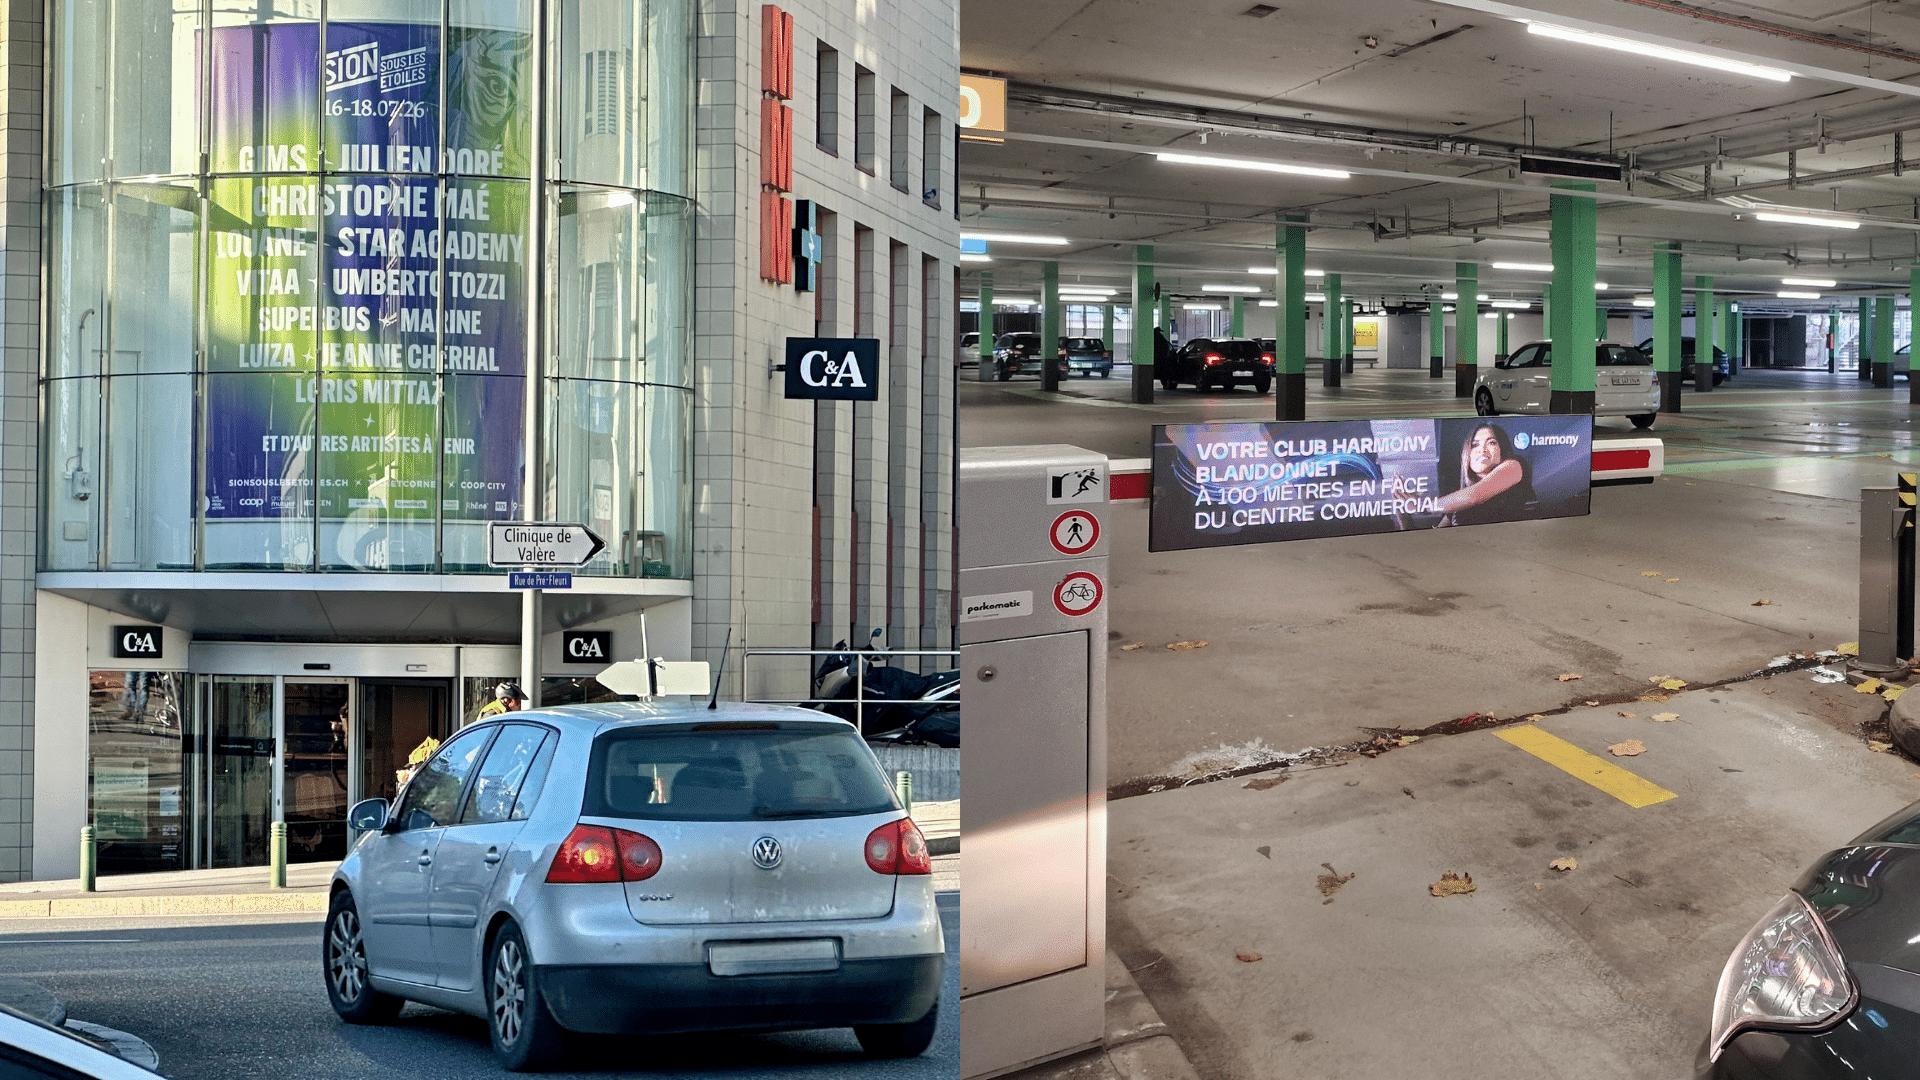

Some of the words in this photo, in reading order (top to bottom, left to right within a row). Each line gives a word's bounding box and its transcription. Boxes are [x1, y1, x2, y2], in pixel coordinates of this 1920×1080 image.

[326, 49, 378, 86] SION
[380, 57, 407, 72] SOUS
[408, 52, 426, 66] LES
[380, 67, 426, 89] ETOILES
[325, 99, 425, 118] 16-18.07.26
[239, 144, 307, 172] GIMS
[338, 144, 431, 172] JULIEN
[253, 184, 427, 217] CHRISTOPHE
[434, 183, 490, 221] MAÉ
[216, 228, 307, 258] LOUANE
[338, 227, 405, 257] STAR
[410, 229, 524, 263] ACADEMY
[236, 268, 300, 296] VITAA
[332, 268, 438, 297] UMBERTO
[449, 272, 506, 300] TOZZI
[239, 343, 296, 368] LUIZA
[321, 343, 402, 369] JEANNE
[800, 350, 867, 388] C&A
[295, 378, 358, 403] LORIS
[262, 435, 278, 452] ET
[280, 435, 348, 452] D'AURES
[351, 435, 420, 453] ARTISTES
[422, 432, 433, 454] À
[442, 437, 476, 455] ENIR
[1196, 441, 1268, 460] VOTRE
[1274, 439, 1327, 457] CLUB
[1332, 435, 1430, 455] HARMONY
[1531, 433, 1579, 448] harmony
[1196, 460, 1339, 484] BLANDONNET
[228, 478, 349, 487] SIONSOUSLESETOIES.CH
[460, 481, 485, 490] COOP
[487, 482, 506, 491] CITY
[1195, 485, 1212, 506] À
[1218, 486, 1257, 505] 100
[1263, 480, 1344, 502] MÈTRES
[1349, 480, 1376, 497] EN
[1381, 476, 1429, 495] FACE
[239, 498, 264, 508] coop
[1194, 511, 1226, 530] DU
[1232, 505, 1315, 527] CENTRE
[1320, 496, 1444, 521] COMMERCIAL
[504, 528, 554, 546] Clinique
[556, 528, 572, 543] de
[517, 546, 556, 561] Valère
[514, 574, 526, 583] Rue
[526, 574, 534, 583] de
[967, 600, 1021, 614] parkomatic
[123, 632, 157, 652] C&A
[569, 637, 604, 657] C&A
